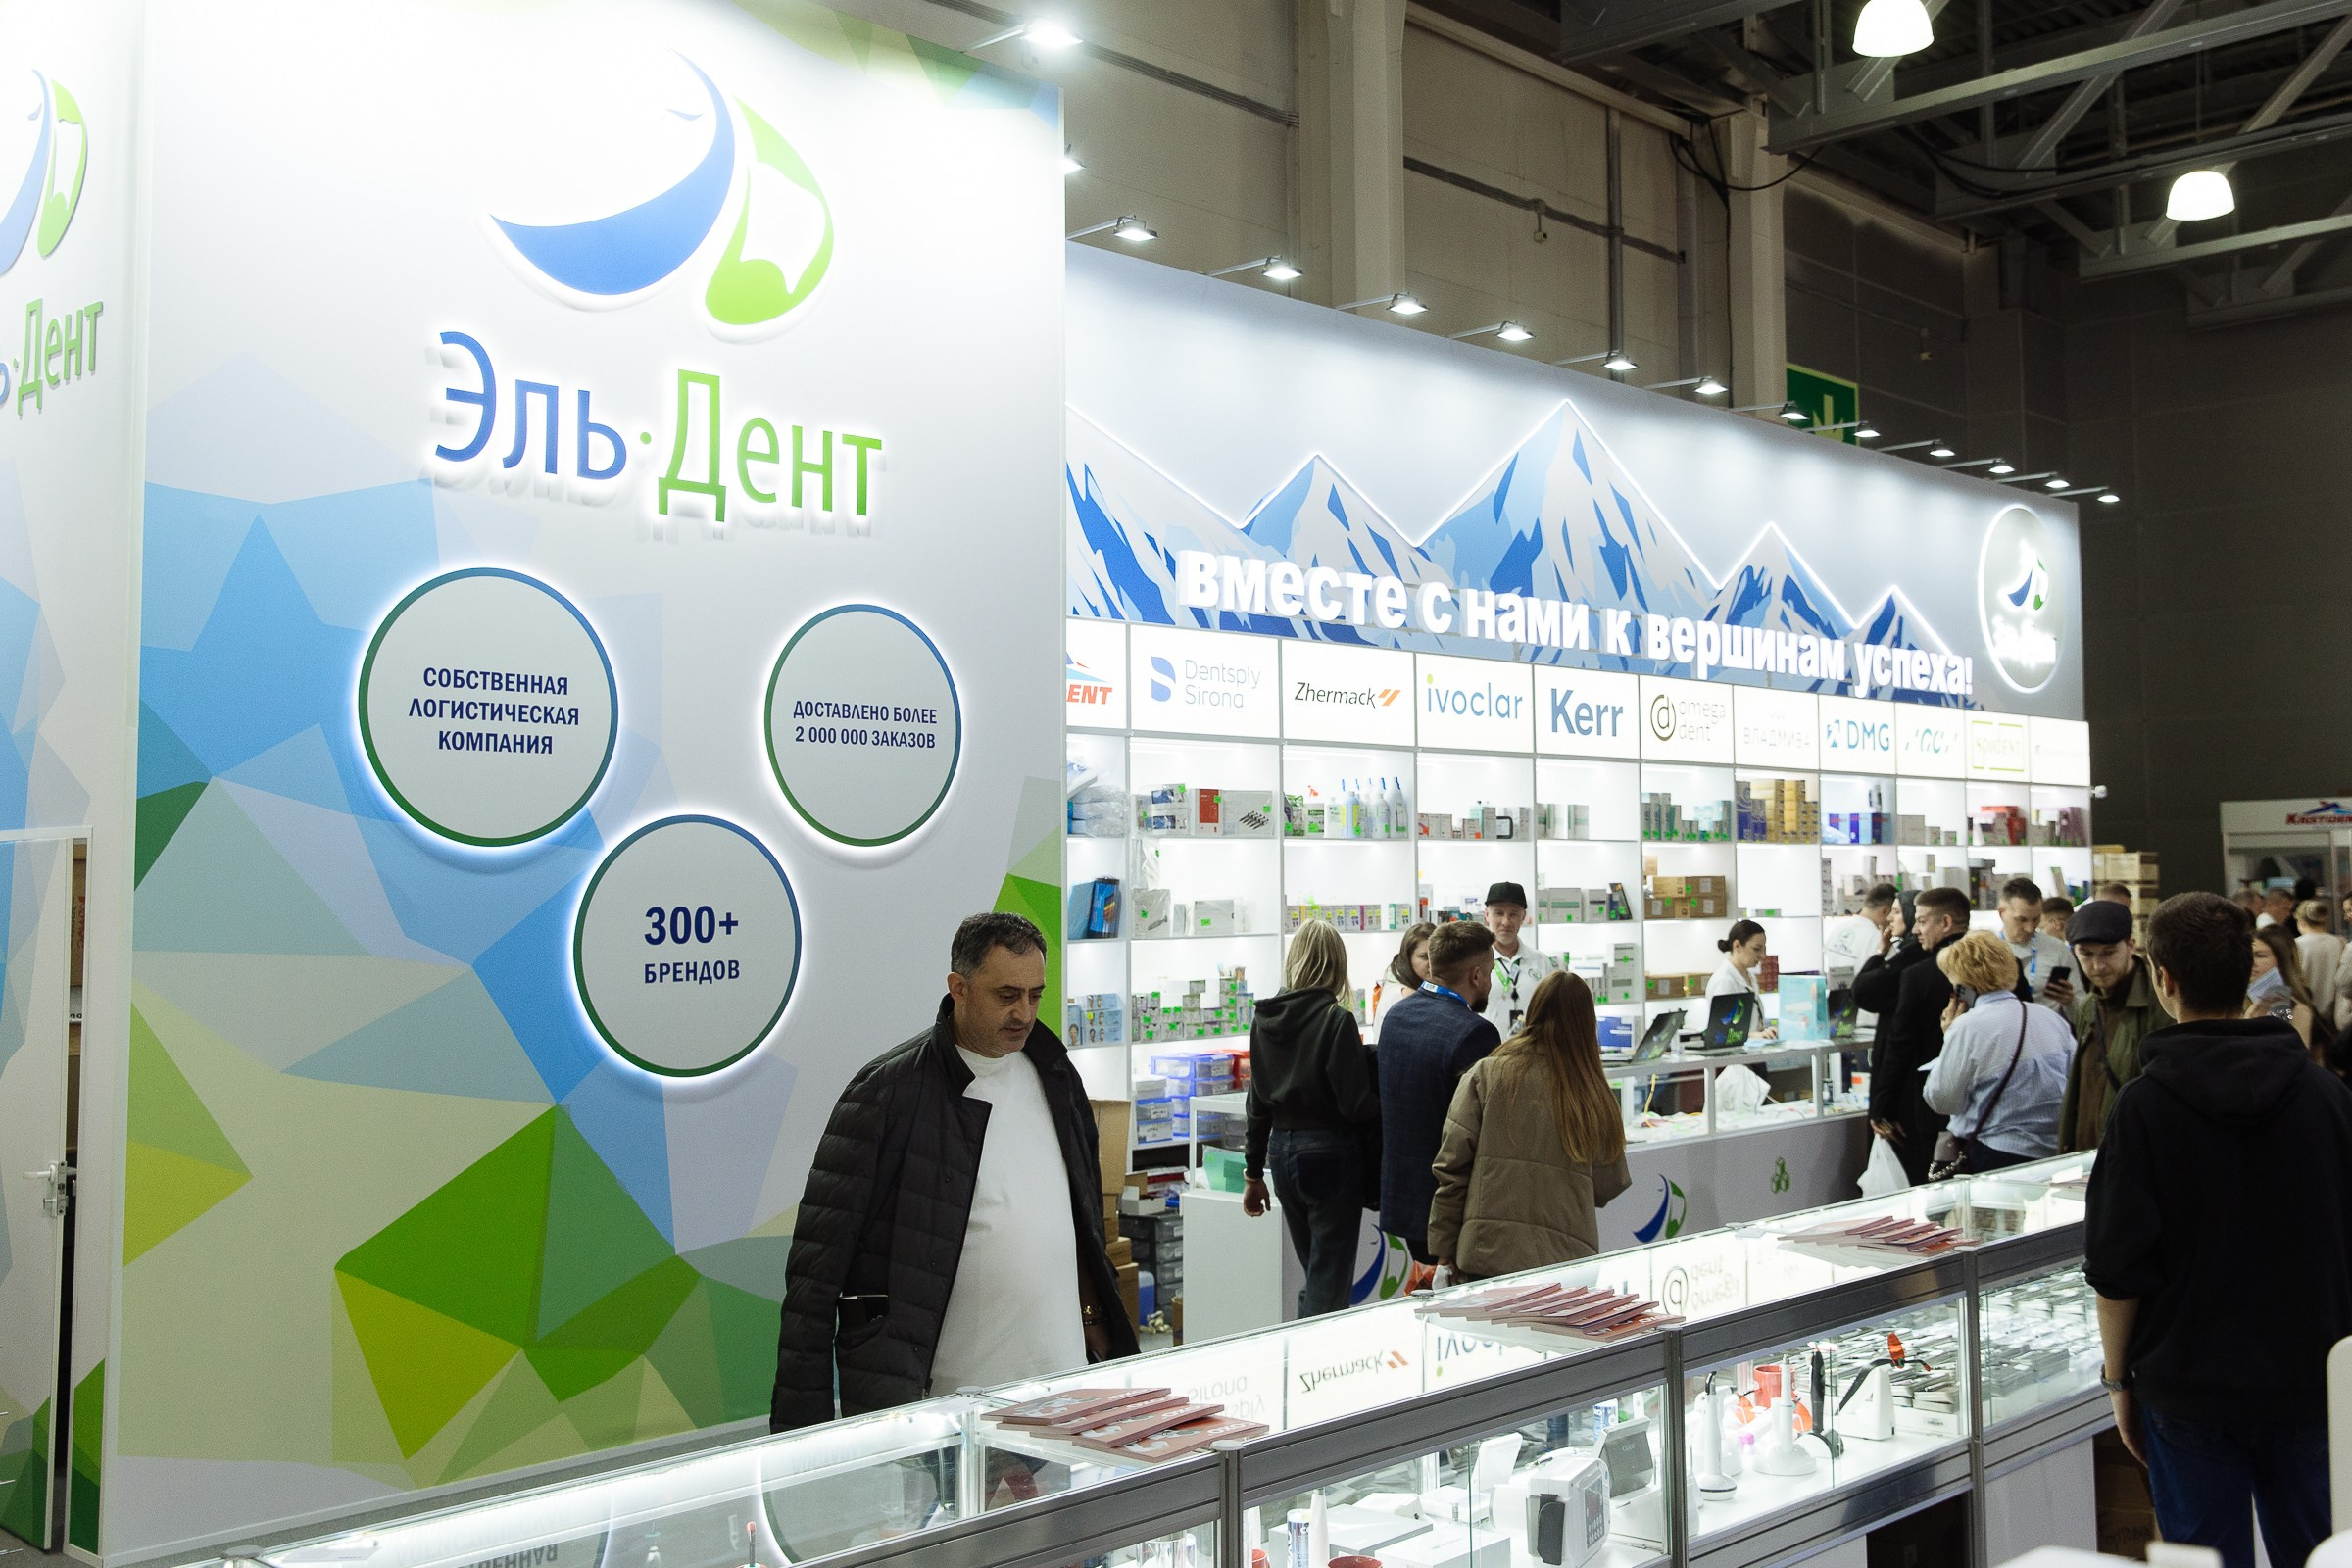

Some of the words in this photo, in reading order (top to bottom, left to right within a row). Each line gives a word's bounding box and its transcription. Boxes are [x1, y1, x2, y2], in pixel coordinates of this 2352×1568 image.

[1420, 580, 1454, 635] с
[1462, 588, 1590, 651] нами
[1604, 607, 1633, 656] к
[1645, 613, 1846, 680] вершинам
[1853, 640, 1974, 699] успеха!
[423, 667, 568, 696] СОБСТВЕННАЯ
[1184, 659, 1261, 690] Dentsply
[1066, 683, 1113, 706] ENT
[1184, 685, 1245, 709] Sirona
[1294, 681, 1377, 709] Zhermack
[1426, 673, 1524, 719] ivoclar
[408, 698, 579, 726] ЛОГИСТИЧЕСКАЯ
[793, 700, 890, 722] ДОСТАВЛЕНО
[893, 706, 938, 725] БОЛЕЕ
[1550, 688, 1624, 737] Kerr
[1679, 700, 1727, 725] omega
[438, 730, 553, 755] КОМПАНИЯ
[795, 725, 805, 743] 2
[808, 726, 837, 745] 000
[840, 728, 868, 746] 000
[871, 730, 936, 750] ЗАКАЗОВ
[1679, 722, 1712, 742] dent
[1846, 720, 1890, 751] DMG
[644, 905, 740, 946] 300+
[644, 959, 741, 986] БРЕНДОВ
